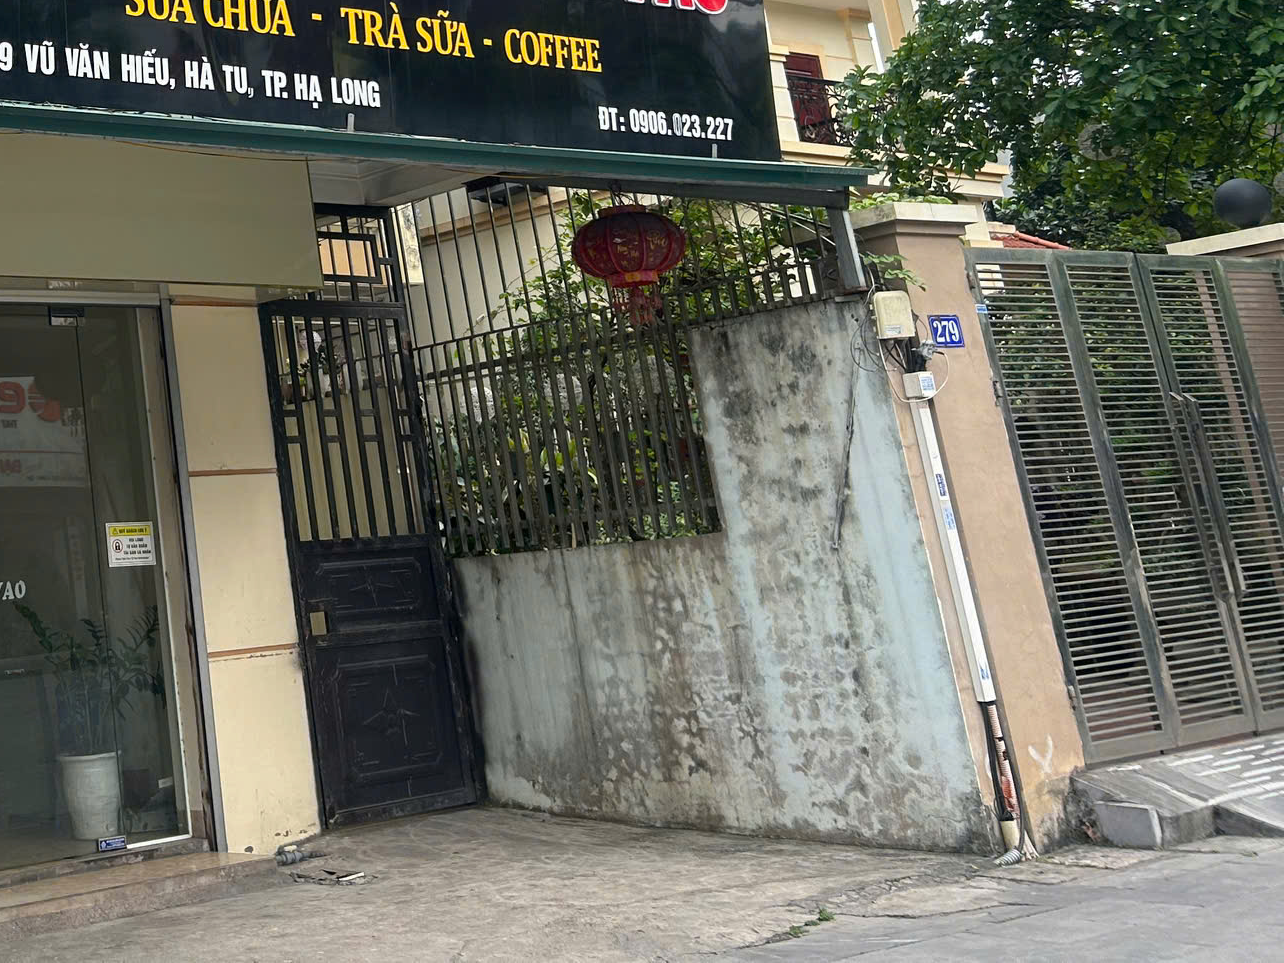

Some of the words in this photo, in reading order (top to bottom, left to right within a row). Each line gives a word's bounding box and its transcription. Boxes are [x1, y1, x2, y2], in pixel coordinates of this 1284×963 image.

[340, 2, 410, 50] TRÀ
[416, 10, 475, 58] SỮA
[504, 28, 602, 72] COFFEE
[24, 41, 55, 76] VŨ
[65, 43, 110, 80] VĂN
[121, 48, 176, 90] HIẾU,
[184, 56, 215, 91] HÀ
[222, 65, 254, 98] TU,
[261, 70, 288, 99] TP.
[294, 73, 323, 109] HẠ
[330, 77, 380, 108] LONG
[629, 108, 733, 141] 0906.023.227
[932, 320, 960, 343] 279
